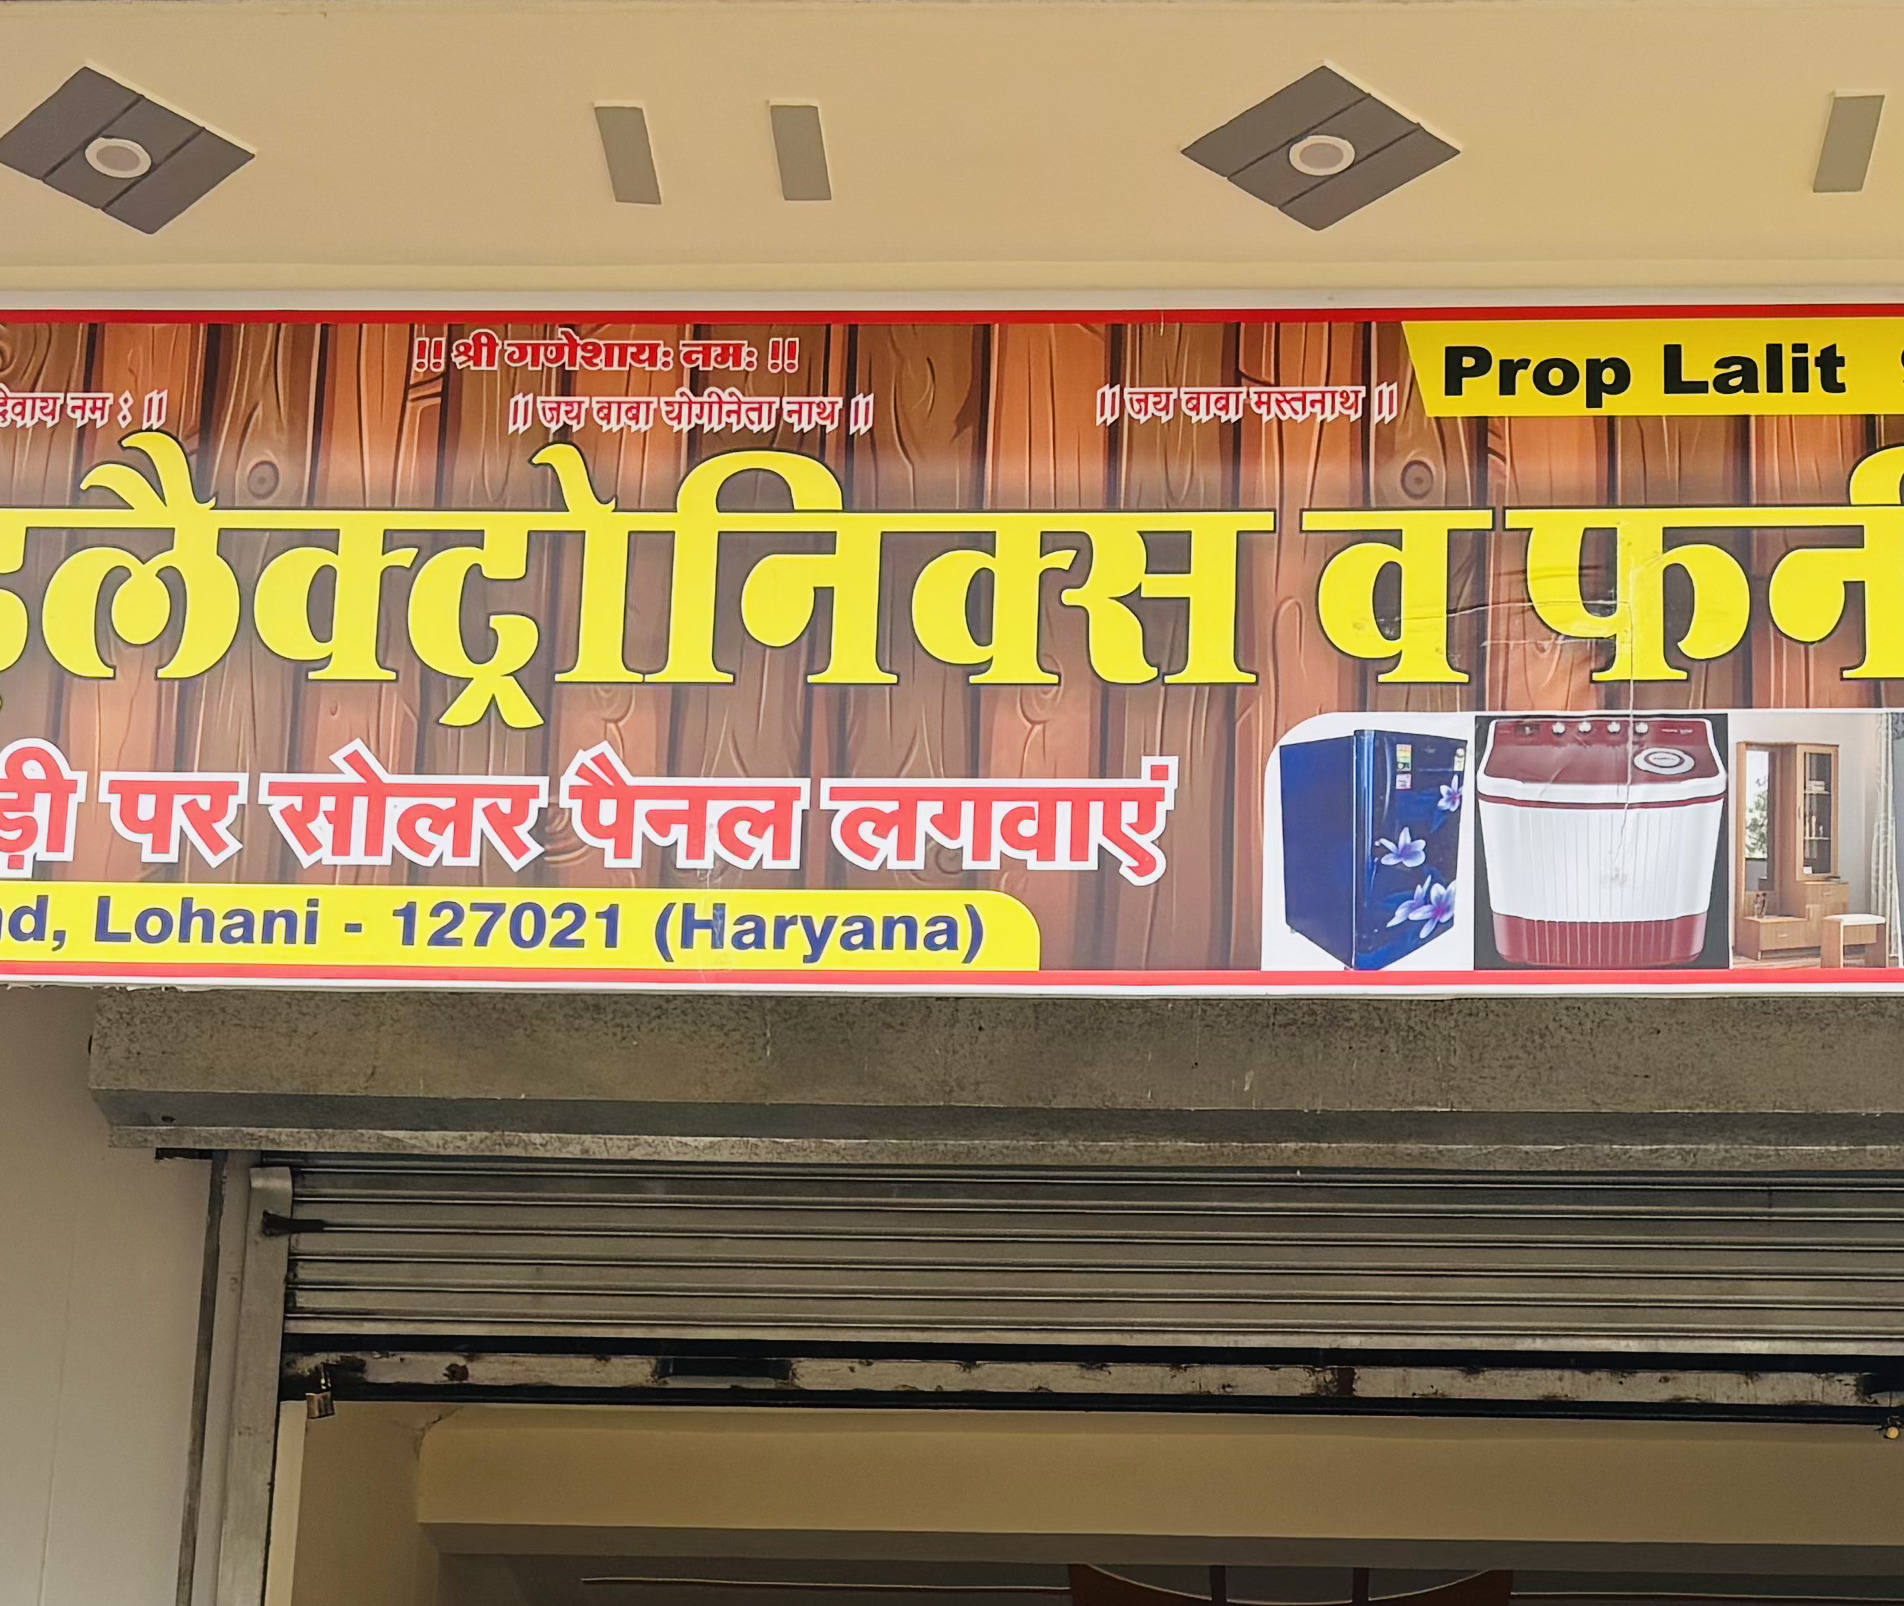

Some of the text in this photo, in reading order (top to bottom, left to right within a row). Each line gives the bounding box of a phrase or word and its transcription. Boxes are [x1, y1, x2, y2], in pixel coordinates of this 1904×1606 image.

[451, 327, 502, 372] श्री
[1444, 343, 1632, 409] Prop
[1663, 341, 1845, 397] Lalit
[536, 395, 590, 434] जय
[591, 396, 658, 434] बाबा
[782, 396, 843, 434] नाथ
[1123, 386, 1178, 425] जय
[1180, 386, 1248, 425] बाबा
[1249, 385, 1367, 425] मस्तनाथ
[1297, 505, 1494, 685] व
[98, 770, 249, 869] पर
[262, 742, 547, 872] सोलर
[562, 742, 812, 871] पैनल
[821, 754, 1181, 887] लगवाएं
[97, 896, 320, 947] Lohani
[392, 900, 623, 950] 127021
[654, 900, 984, 964] (Haryana)
